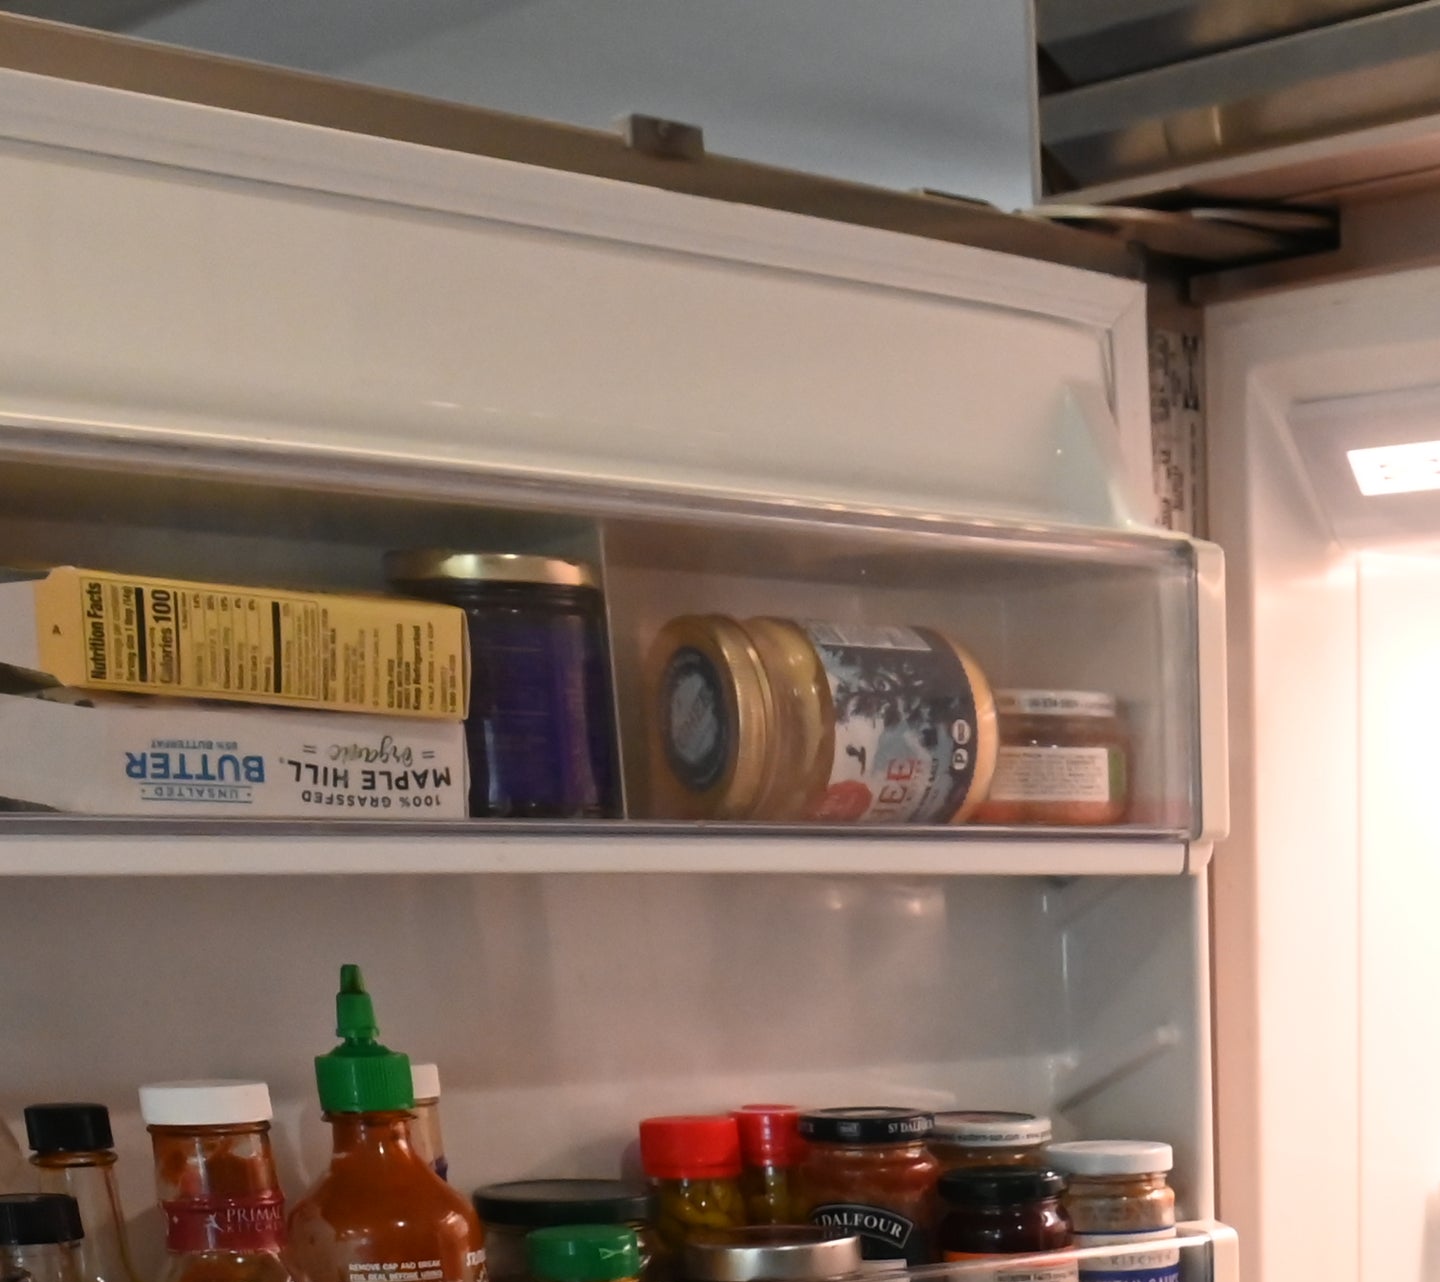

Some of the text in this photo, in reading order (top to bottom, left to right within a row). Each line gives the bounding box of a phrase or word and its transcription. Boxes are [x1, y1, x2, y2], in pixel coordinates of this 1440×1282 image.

[151, 589, 172, 624] 100
[86, 583, 107, 681] Nutrition Facts
[124, 751, 265, 783] BUTTER
[286, 760, 452, 790] MAPLE HILL
[154, 786, 238, 798] UNSALTED
[302, 790, 440, 808] 100% GRASSFED
[821, 1213, 903, 1238] DALFOUR
[349, 1260, 441, 1272] REMOVE CAP AND BREAK
